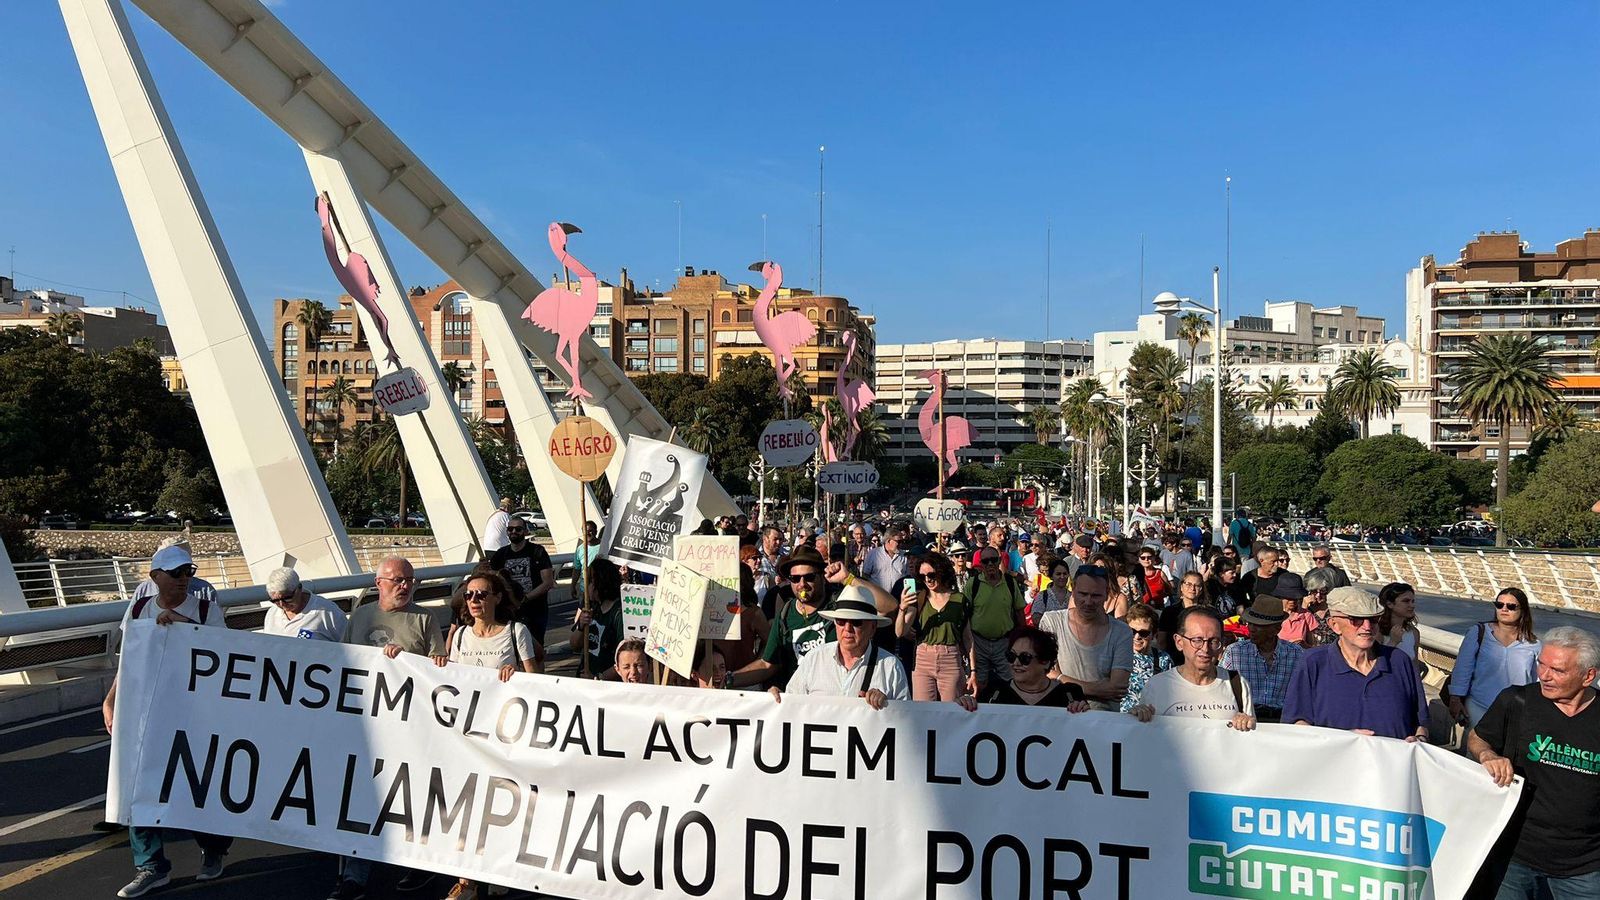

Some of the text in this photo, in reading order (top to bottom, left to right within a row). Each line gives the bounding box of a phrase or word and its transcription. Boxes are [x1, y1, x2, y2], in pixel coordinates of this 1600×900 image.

[626, 513, 676, 533] ASSOCIACIÓ
[628, 525, 642, 537] DE
[677, 544, 737, 561] LA COMPRA
[188, 648, 1150, 799] PENSEM GLOBAL ACTUEM LOCAL
[1540, 759, 1572, 770] PLATAFORMA
[158, 729, 260, 814] NO
[270, 747, 317, 826] A
[336, 753, 717, 897] L'AMPLIACIÓ
[926, 830, 1150, 900] PORT
[1231, 806, 1413, 855] COMISSIÓ
